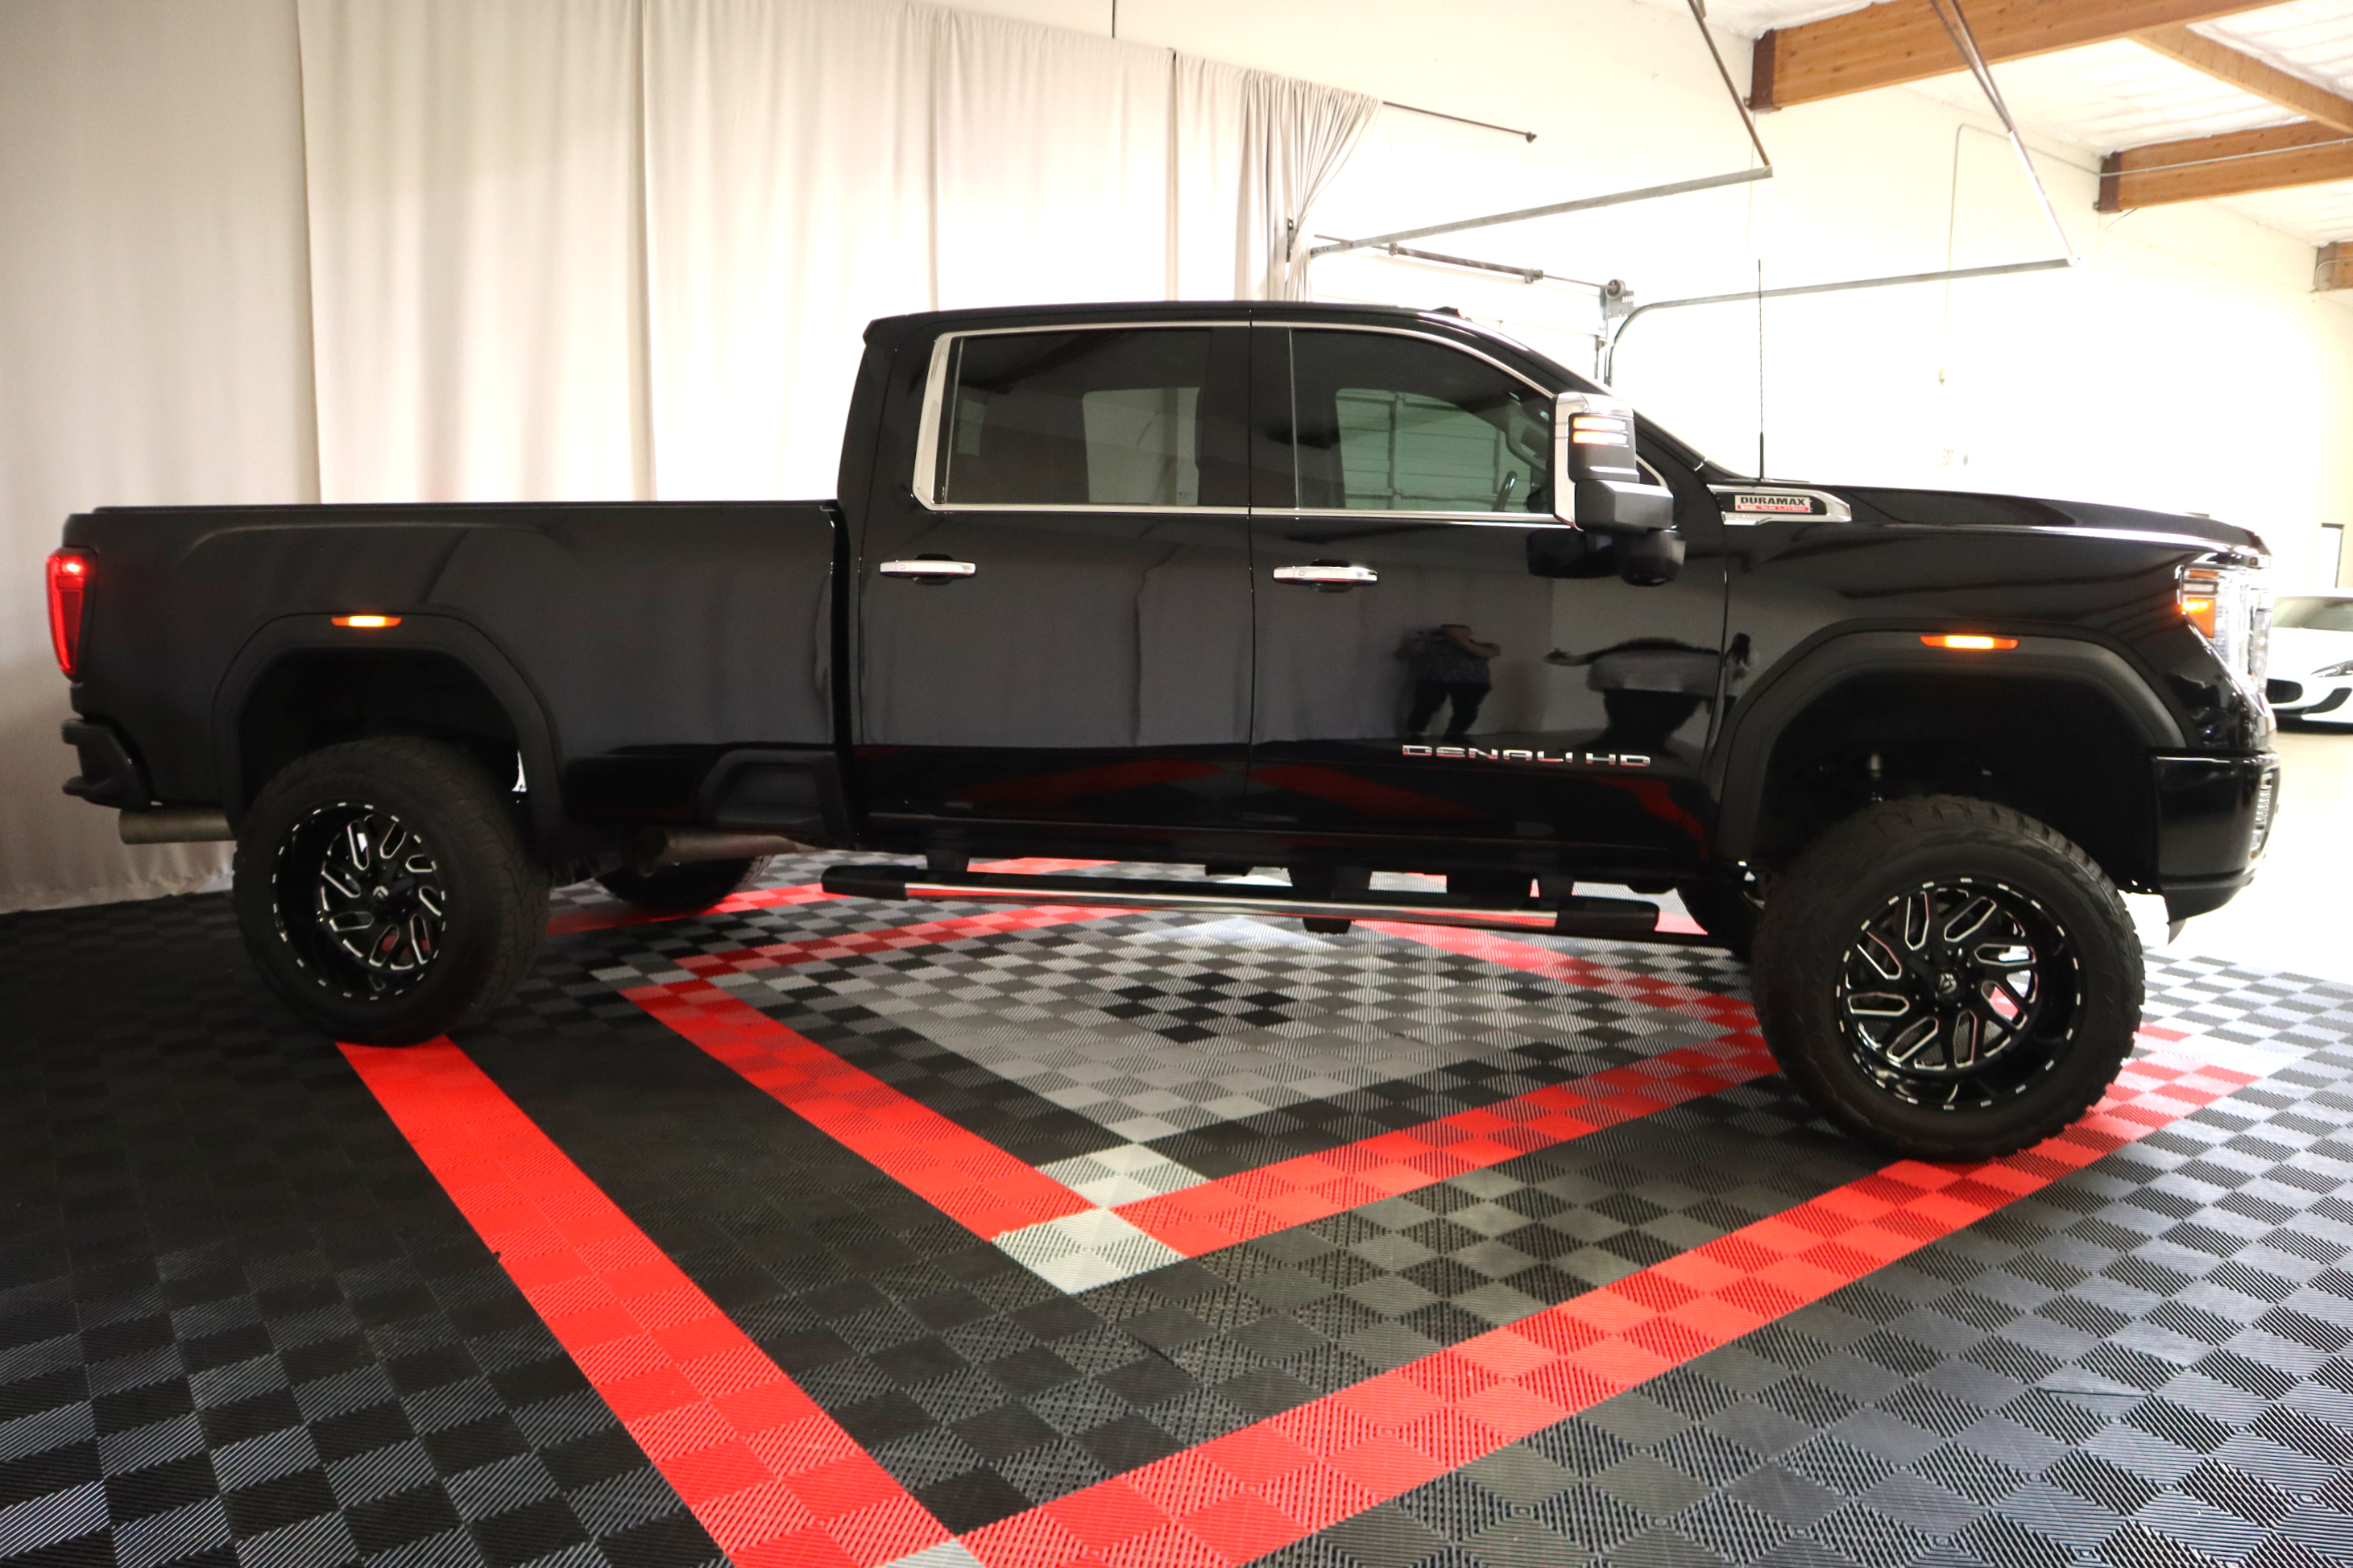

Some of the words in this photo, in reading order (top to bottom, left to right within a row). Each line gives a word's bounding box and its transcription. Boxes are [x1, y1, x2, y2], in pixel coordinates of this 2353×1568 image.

[1740, 497, 1805, 506] DURAMAX
[1402, 745, 1573, 763] DENALI
[1585, 752, 1651, 767] HD
